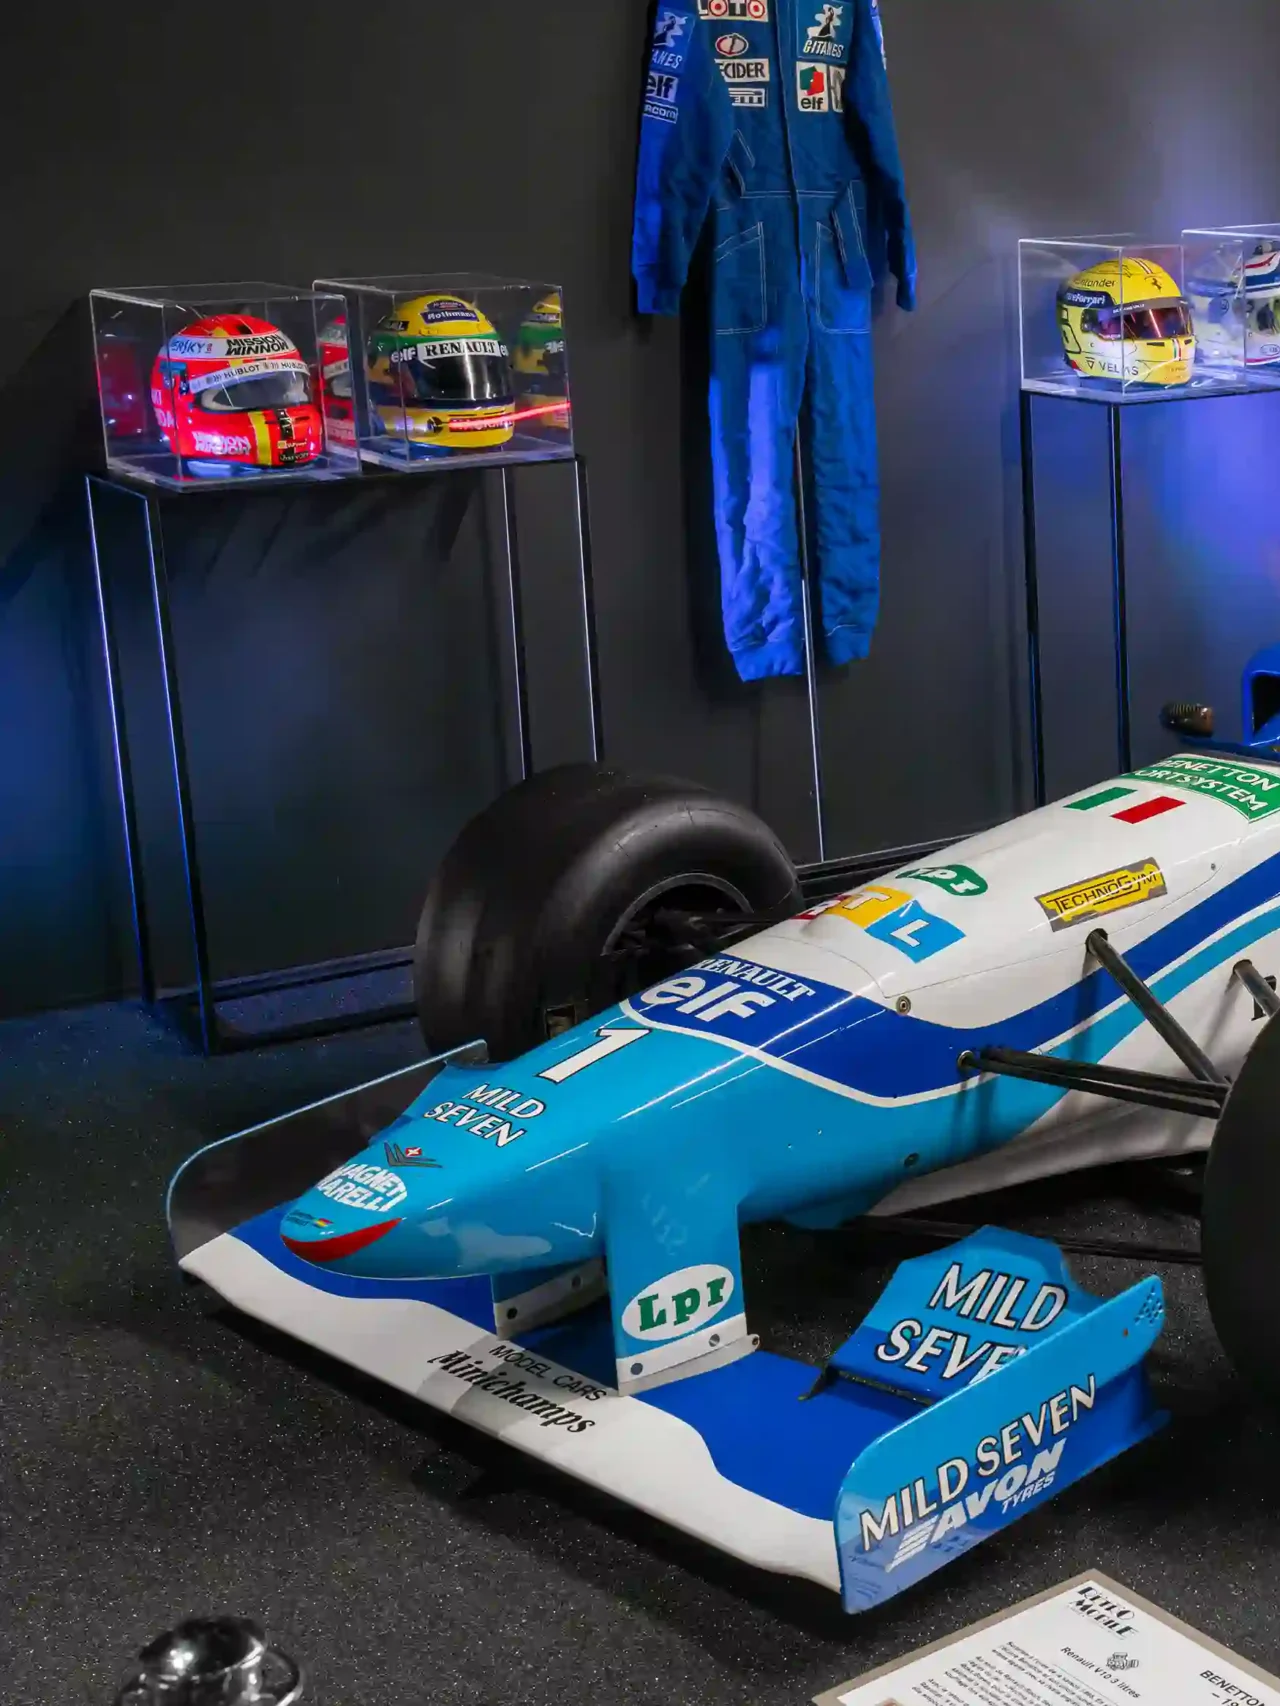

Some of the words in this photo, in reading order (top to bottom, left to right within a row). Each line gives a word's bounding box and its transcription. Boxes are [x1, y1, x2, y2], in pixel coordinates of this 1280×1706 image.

[803, 39, 845, 58] GITANES
[800, 97, 824, 110] elf
[225, 334, 283, 347] MISSION
[225, 341, 290, 357] WINNOW
[391, 346, 418, 364] elf
[425, 341, 497, 357] RENAULT
[223, 364, 261, 379] HUBLOT
[1047, 870, 1158, 915] TECHNOGYM
[640, 976, 777, 1023] elf
[536, 1028, 652, 1085] 1
[423, 1100, 527, 1149] SEVEN
[460, 1082, 547, 1120] MILD
[639, 1276, 727, 1331] Lpr
[927, 1260, 1069, 1332] MILD
[427, 1350, 597, 1434] Minichamps
[488, 1344, 553, 1380] MODEL
[552, 1374, 607, 1403] CARS
[859, 1456, 969, 1552] MILD
[975, 1373, 1097, 1478] SEVEN
[930, 1438, 1067, 1544] AVON
[1001, 1470, 1056, 1515] TYRES
[1061, 1646, 1095, 1670] Renault
[1094, 1666, 1113, 1681] V10
[1110, 1677, 1120, 1685] 3
[1117, 1680, 1141, 1699] litres
